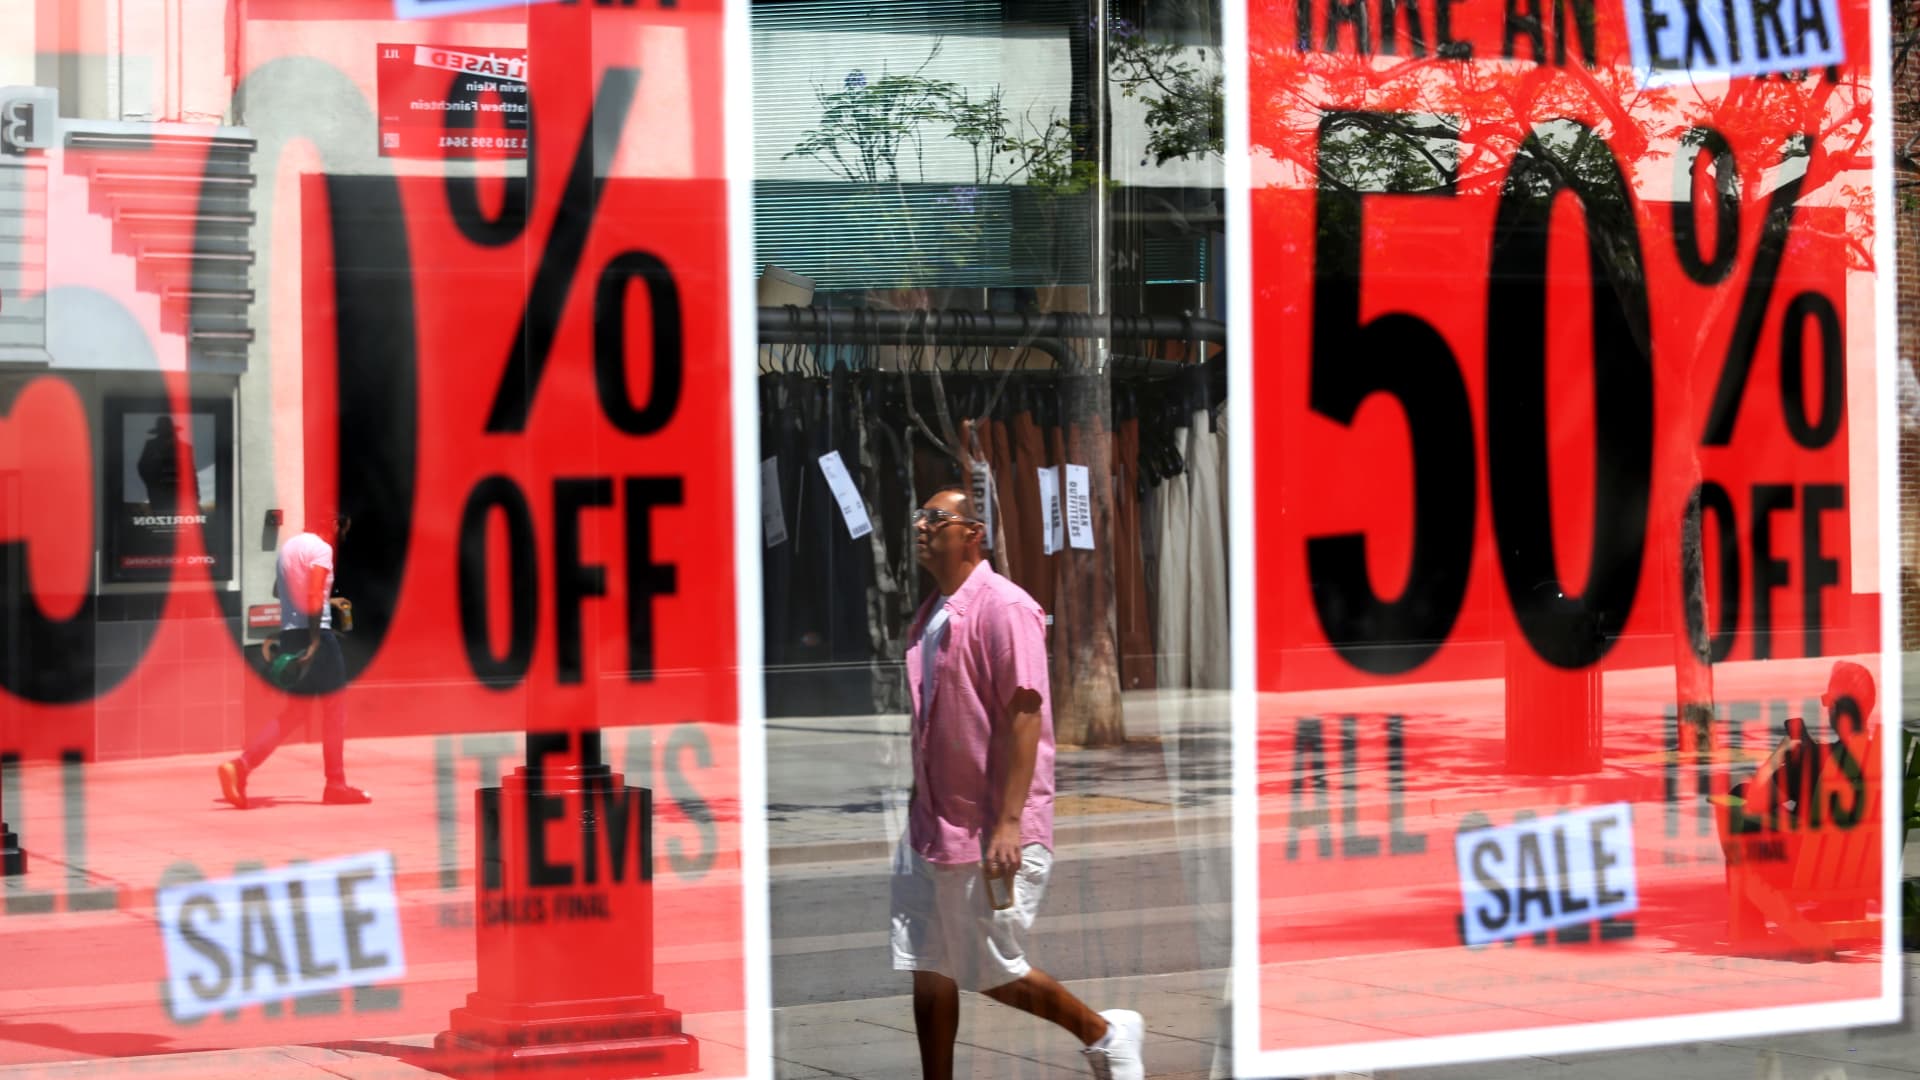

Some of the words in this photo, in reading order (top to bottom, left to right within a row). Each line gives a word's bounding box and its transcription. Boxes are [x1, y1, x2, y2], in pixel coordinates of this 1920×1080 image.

[1641, 0, 1830, 69] EXTRA
[1306, 106, 1844, 678] 50%
[458, 472, 684, 692] OFF
[1681, 481, 1845, 664] OFF
[432, 720, 718, 892] ITEMS
[1286, 714, 1427, 860] ALL
[1664, 695, 1866, 838] ITEMS
[177, 869, 390, 1001] SALE
[1470, 815, 1626, 932] SALE
